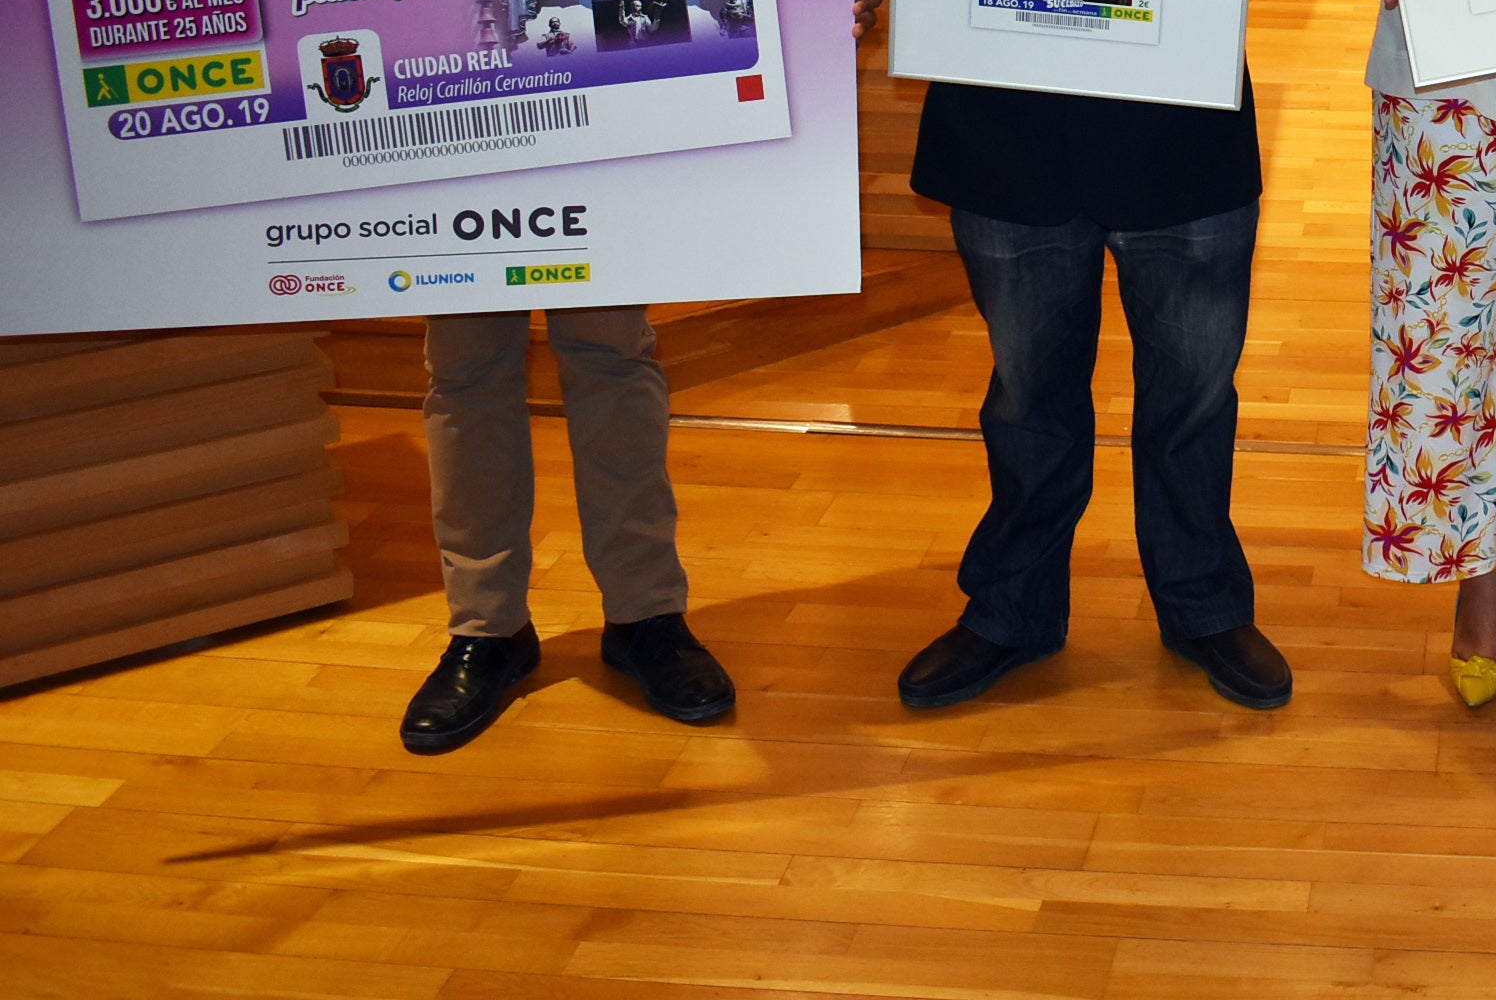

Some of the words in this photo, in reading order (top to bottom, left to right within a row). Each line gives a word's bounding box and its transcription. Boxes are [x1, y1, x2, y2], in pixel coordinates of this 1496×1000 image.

[1023, 0, 1034, 9] 19
[1114, 9, 1150, 21] ONCE
[89, 20, 170, 47] DURANTE
[174, 17, 197, 38] 25
[202, 10, 247, 36] AÑOS
[136, 57, 255, 95] ONCE
[394, 52, 463, 80] CIUDAD
[467, 48, 513, 71] REAL
[397, 83, 433, 105] Reloj
[436, 75, 492, 100] Carillón
[494, 69, 573, 94] Cervantino
[118, 110, 150, 138] 20
[160, 102, 234, 134] AGO.
[237, 97, 270, 124] 19
[265, 221, 351, 247] grupo
[359, 213, 438, 238] social
[452, 205, 588, 241] ONCE
[305, 274, 345, 283] Fundación
[416, 272, 475, 286] ILUNION
[530, 266, 586, 282] ONCE
[305, 281, 345, 293] ONCE
